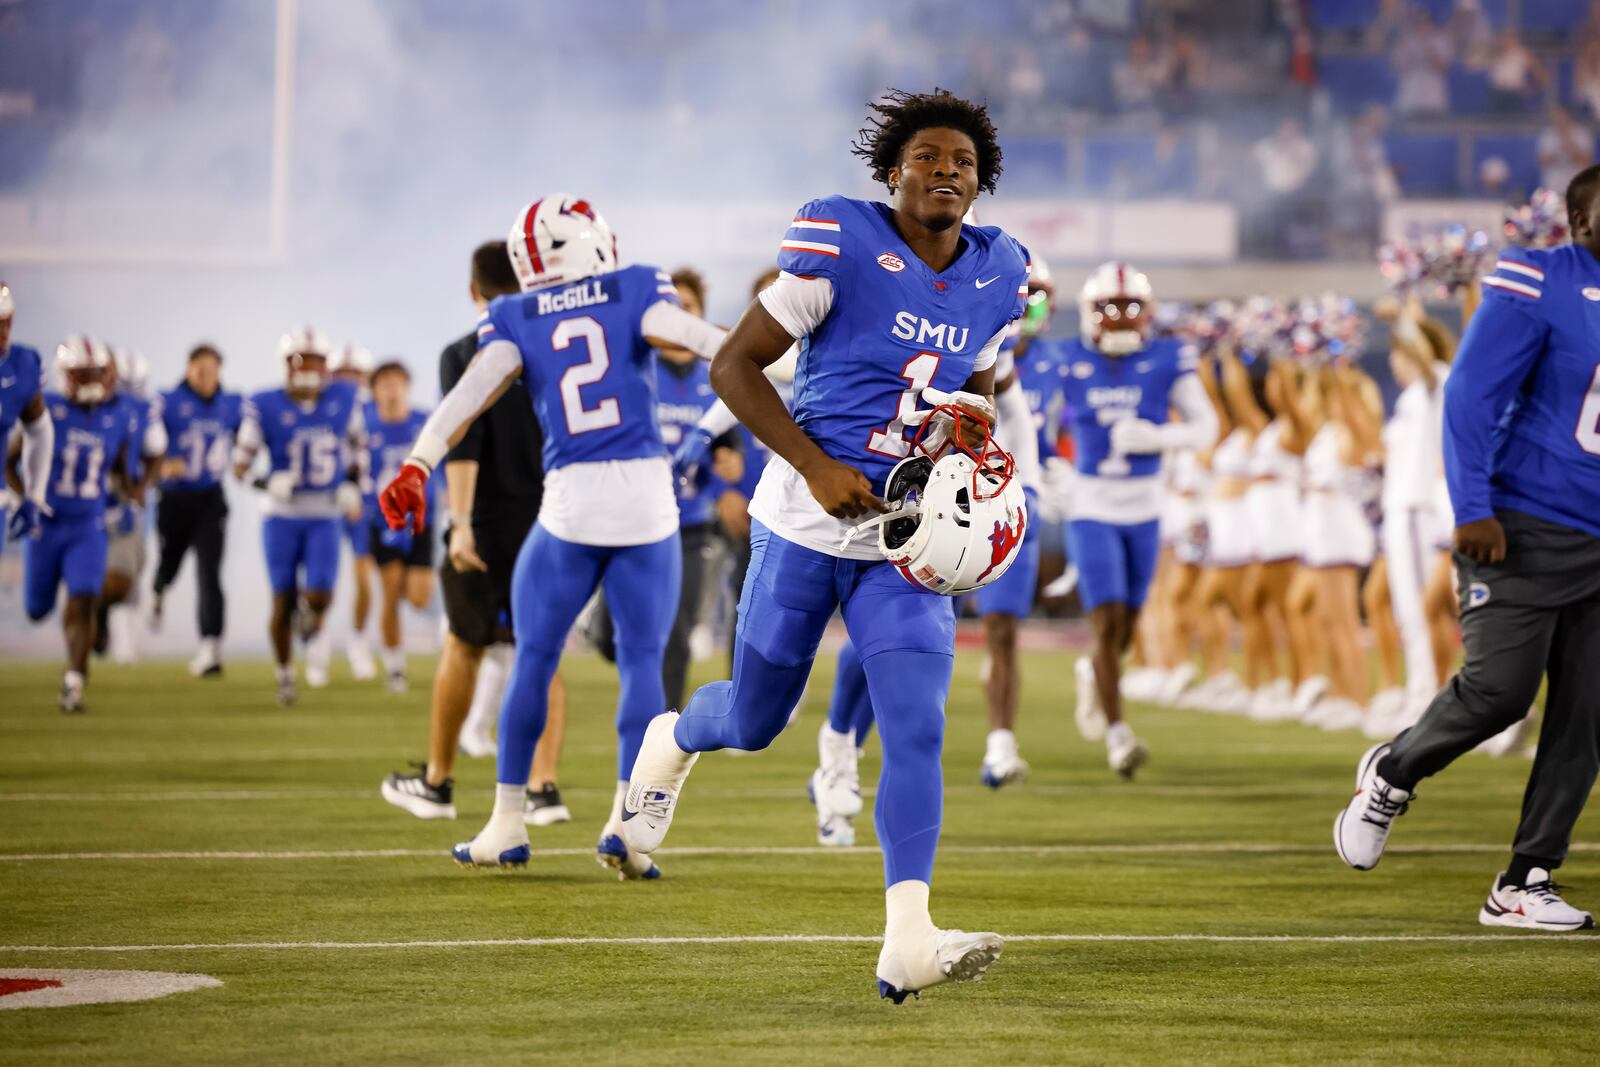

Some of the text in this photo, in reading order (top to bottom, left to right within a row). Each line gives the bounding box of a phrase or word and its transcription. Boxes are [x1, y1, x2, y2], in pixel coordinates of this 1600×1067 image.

[879, 256, 903, 270] ACC
[537, 281, 609, 316] McGILL
[891, 311, 969, 352] SMU
[551, 316, 622, 435] 2
[864, 350, 942, 460] 1
[54, 443, 105, 500] 11
